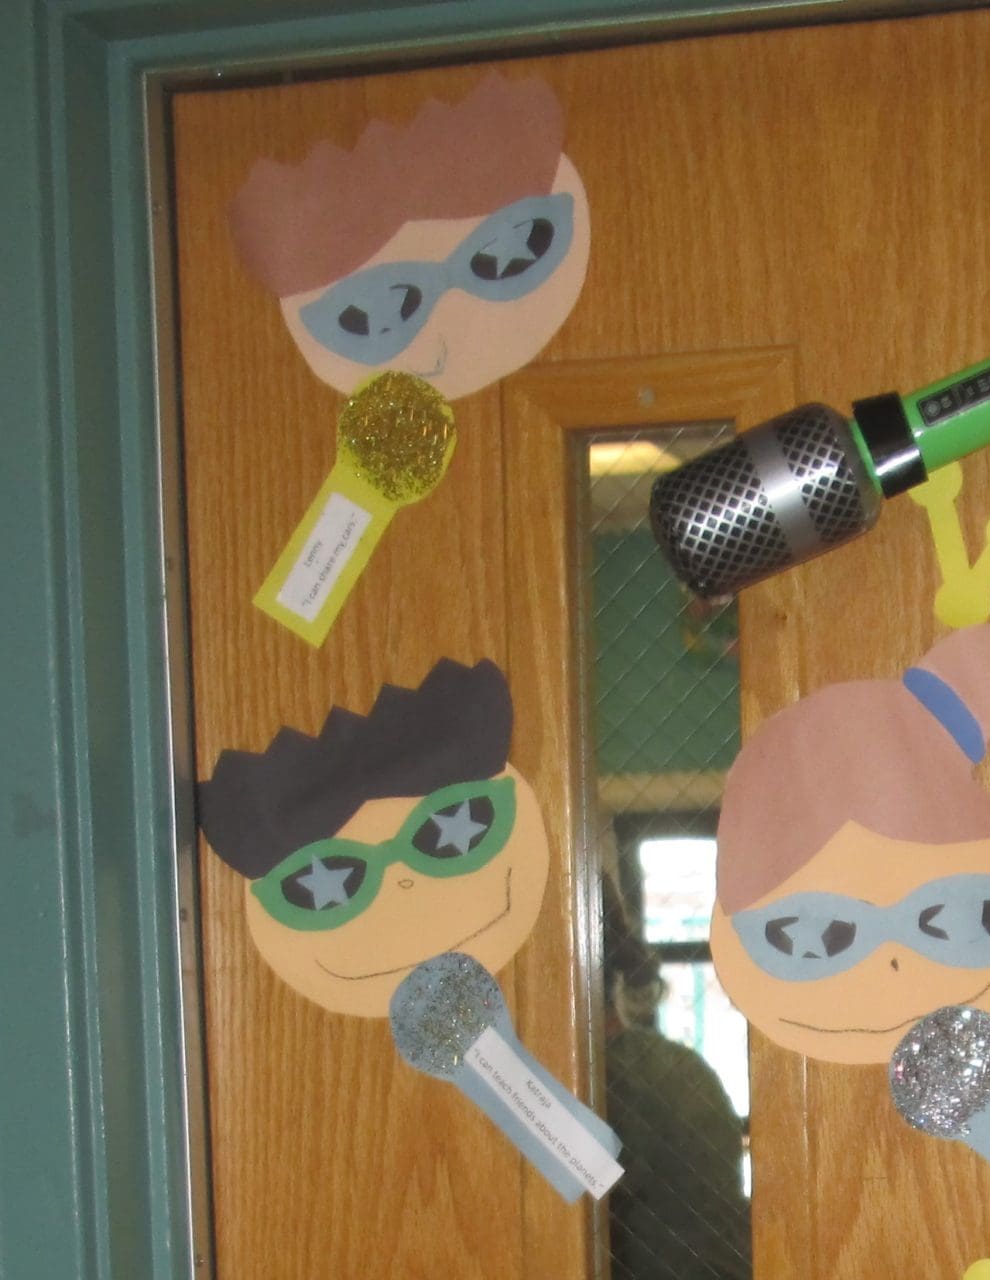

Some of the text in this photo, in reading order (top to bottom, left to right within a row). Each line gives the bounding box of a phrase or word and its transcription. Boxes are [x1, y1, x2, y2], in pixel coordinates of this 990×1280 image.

[310, 581, 321, 600] can
[478, 1056, 493, 1073] can
[491, 1070, 513, 1096] teach
[511, 1090, 537, 1123] friends
[535, 1119, 560, 1146] about
[556, 1142, 572, 1159] the
